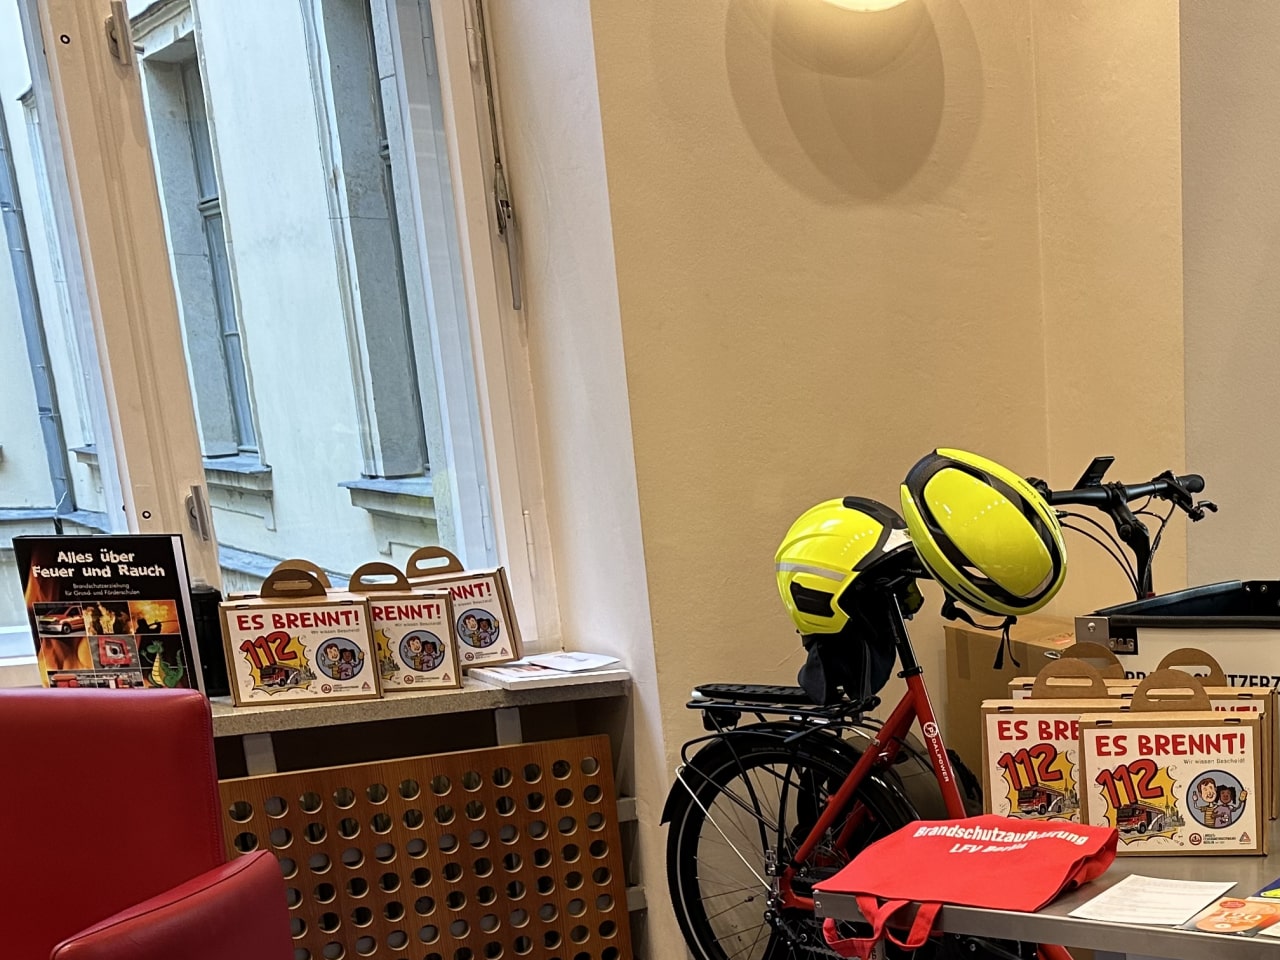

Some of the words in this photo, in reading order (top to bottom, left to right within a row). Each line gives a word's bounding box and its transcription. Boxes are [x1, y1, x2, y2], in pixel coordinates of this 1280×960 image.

[57, 550, 94, 564] Alles
[100, 548, 135, 564] über
[32, 565, 75, 578] Feuer
[82, 564, 111, 578] und
[118, 563, 166, 577] Rauch
[450, 582, 492, 601] NNT!
[236, 614, 265, 631] ES
[272, 610, 360, 629] BRENNT!
[371, 604, 441, 621] RENNT!
[240, 631, 298, 669] 112
[997, 720, 1028, 741] ES
[1095, 735, 1128, 757] ES
[1138, 733, 1246, 756] BRENNT!
[997, 743, 1064, 791] 112
[1094, 758, 1165, 808] 112
[949, 843, 984, 853] LFV
